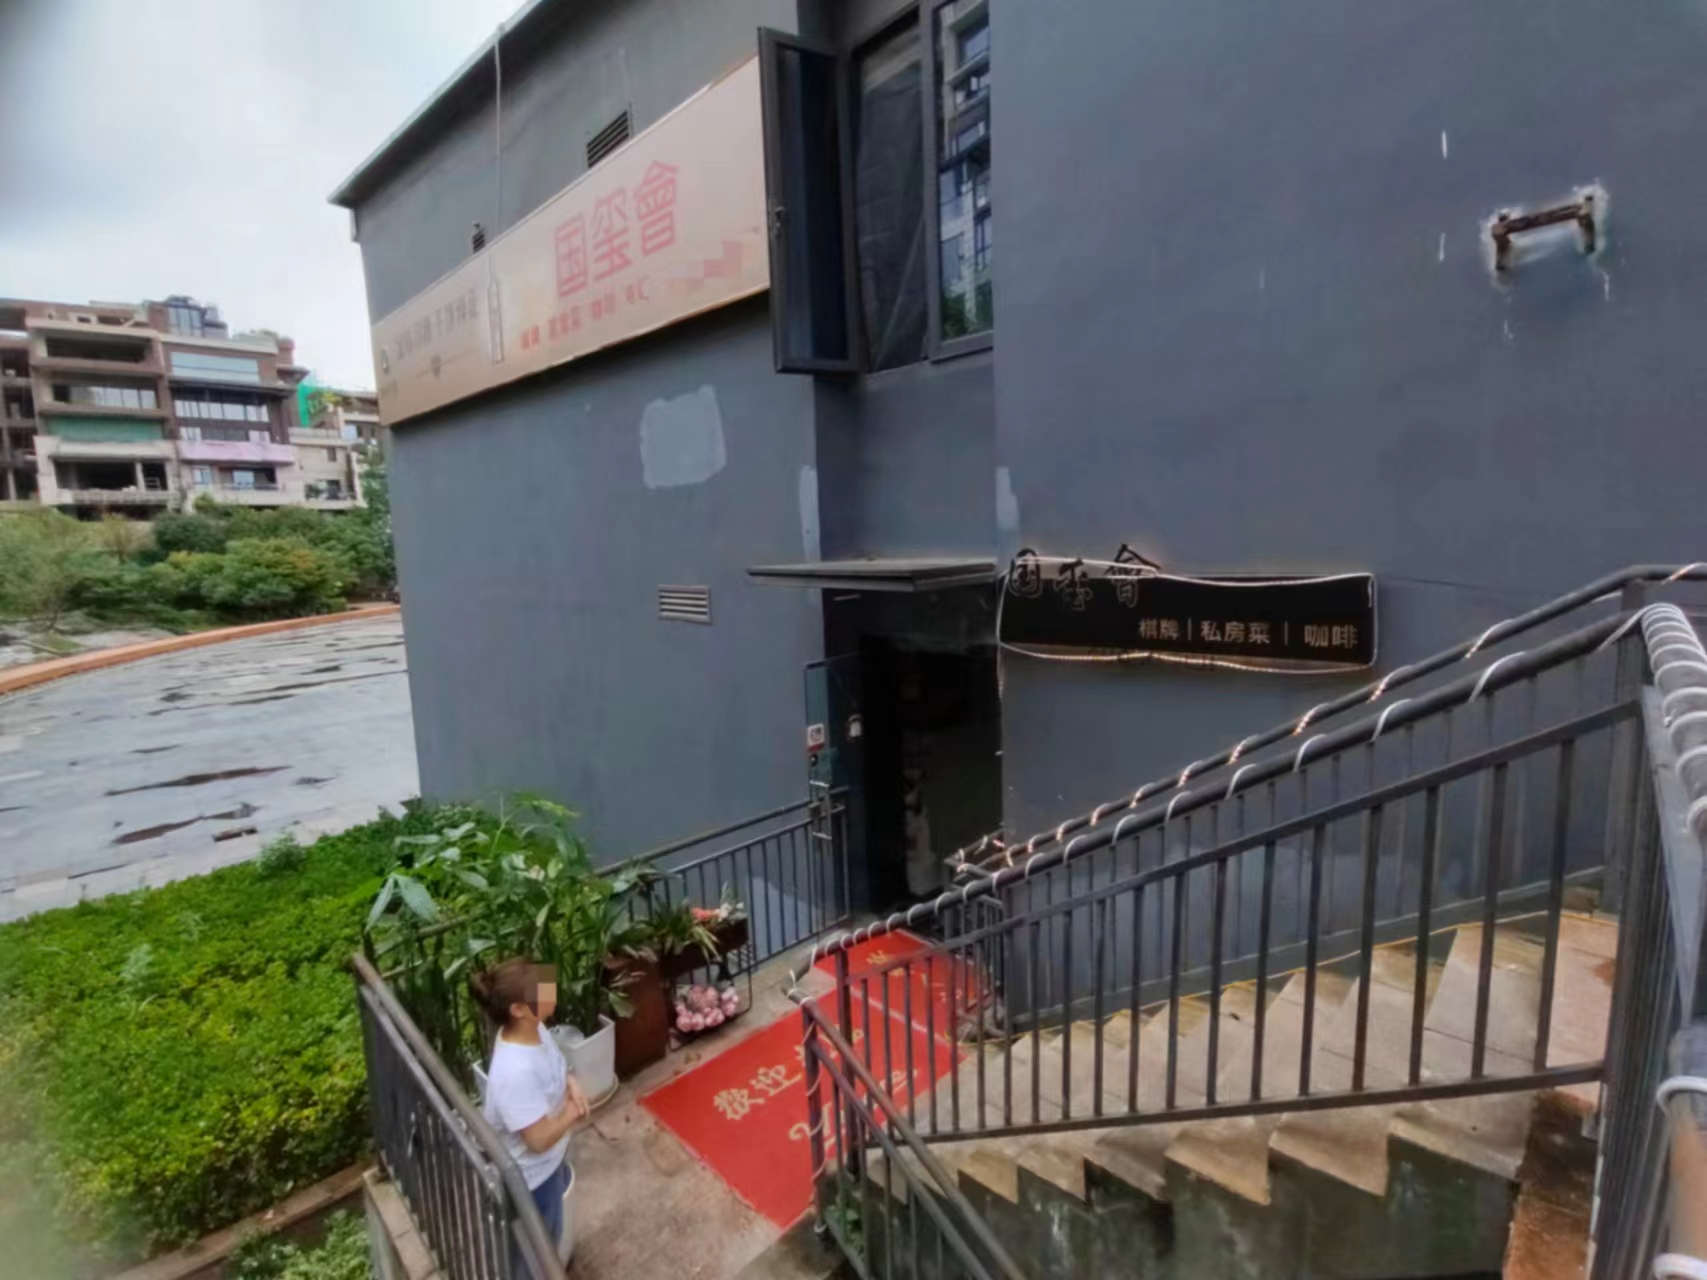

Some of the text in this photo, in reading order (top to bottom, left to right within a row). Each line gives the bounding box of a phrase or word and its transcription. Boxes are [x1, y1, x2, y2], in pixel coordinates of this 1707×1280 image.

[1138, 619, 1358, 648] 棋牌 私房菜 咖啡
